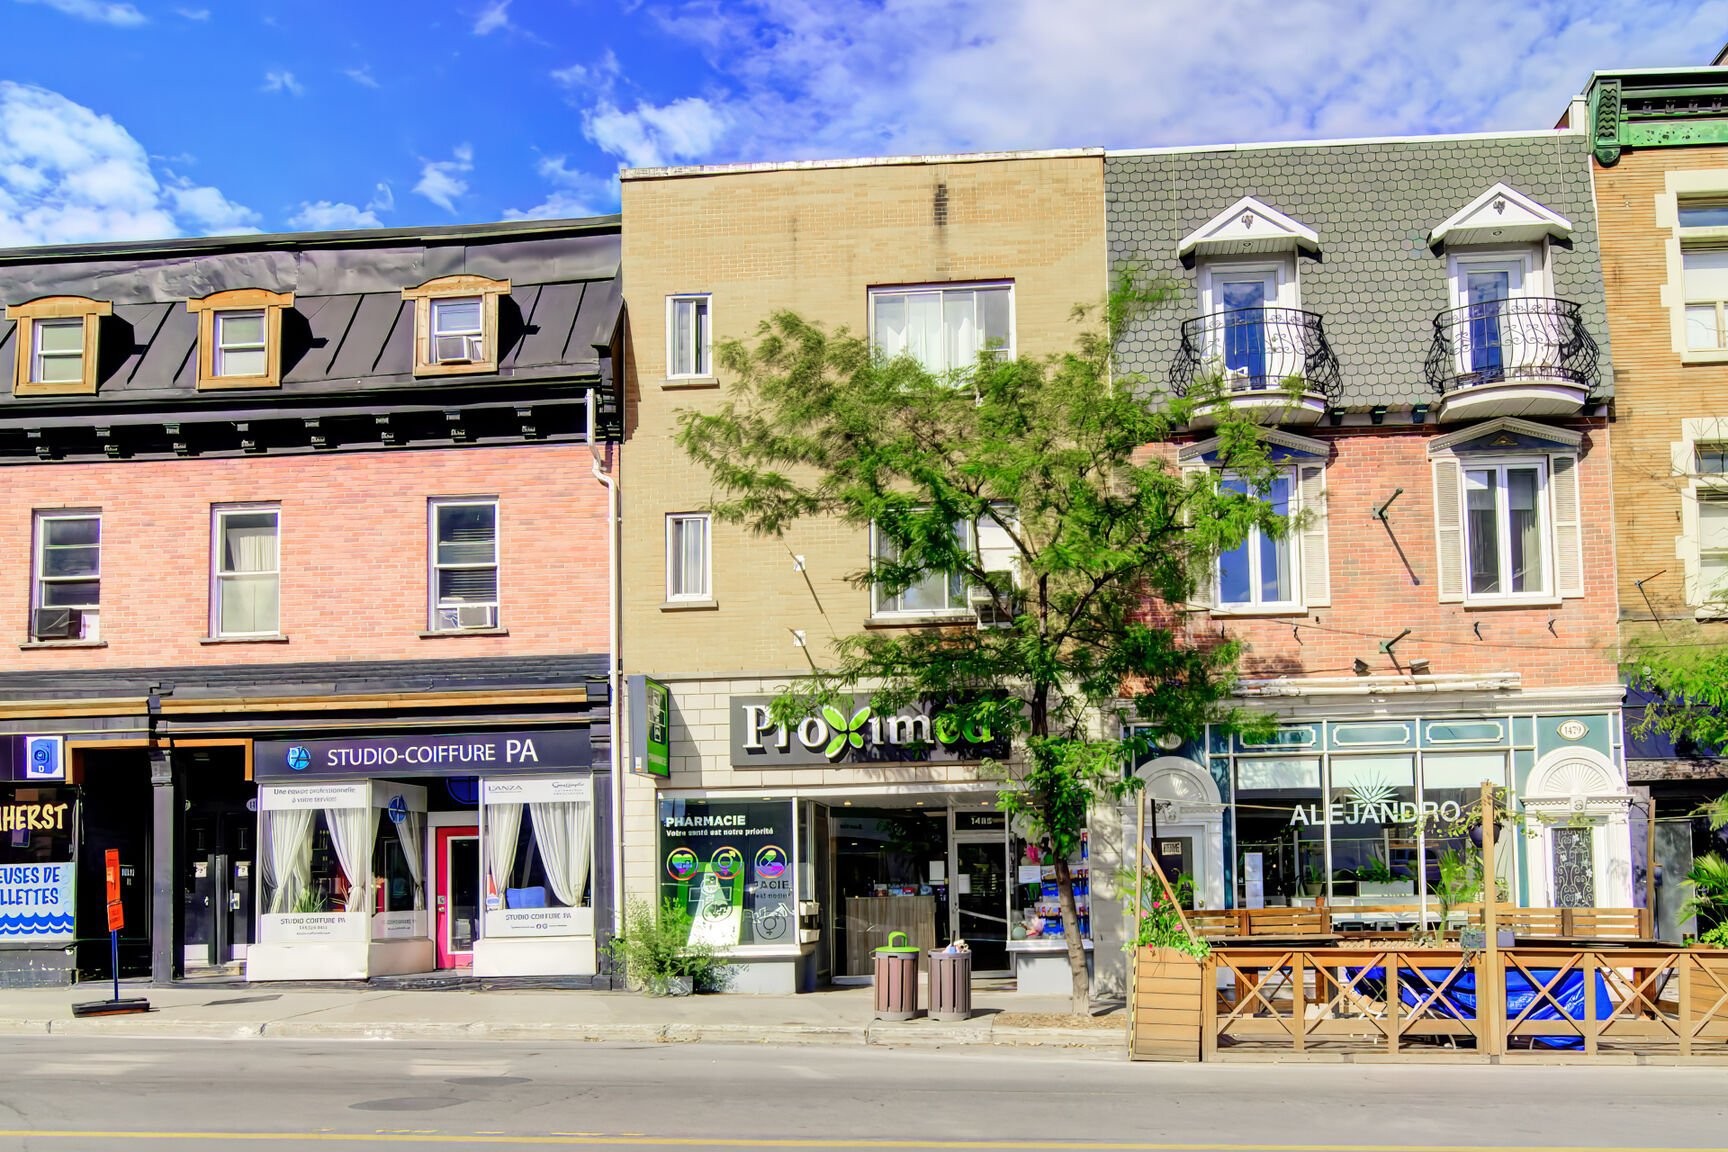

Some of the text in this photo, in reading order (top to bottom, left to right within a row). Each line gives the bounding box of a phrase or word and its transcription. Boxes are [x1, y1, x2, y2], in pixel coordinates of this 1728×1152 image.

[327, 739, 539, 766] STUDIO-COIFFURE PA
[1289, 800, 1461, 826] ALEJANDRO
[665, 815, 746, 828] PHARMACIE
[666, 829, 686, 837] Votre
[745, 827, 774, 836] priorité
[43, 867, 61, 883] DE
[505, 913, 530, 921] STUDIO
